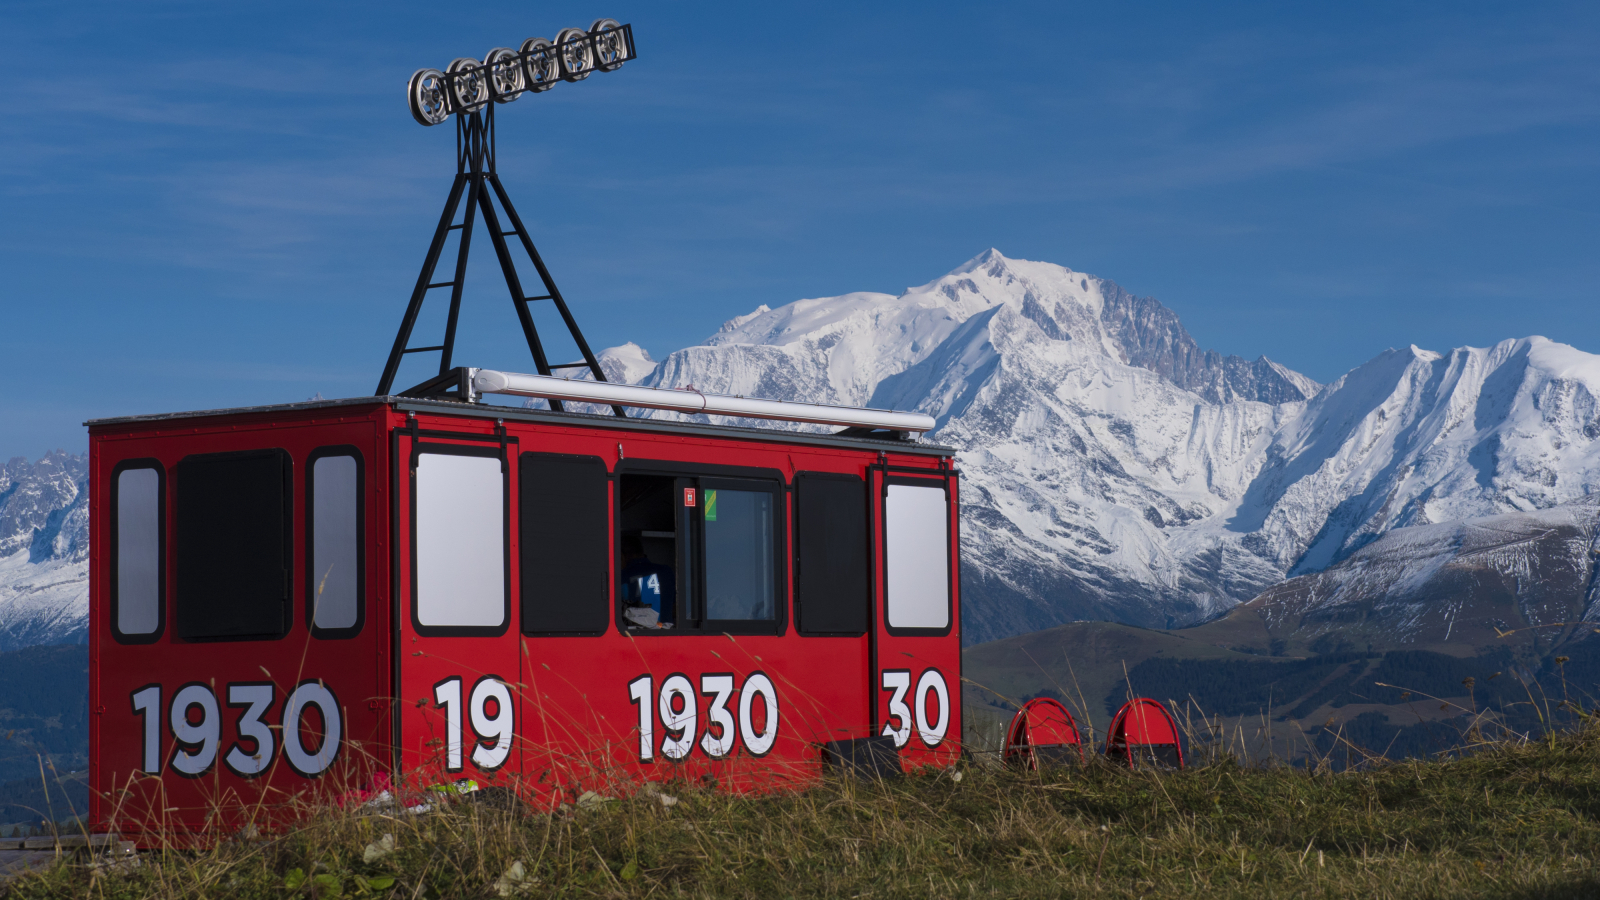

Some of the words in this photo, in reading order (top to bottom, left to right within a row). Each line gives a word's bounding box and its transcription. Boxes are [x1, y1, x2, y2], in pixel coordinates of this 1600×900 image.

[130, 678, 342, 778] 1930
[433, 674, 516, 773] 19
[628, 670, 779, 764] 1930
[881, 667, 950, 750] 30
